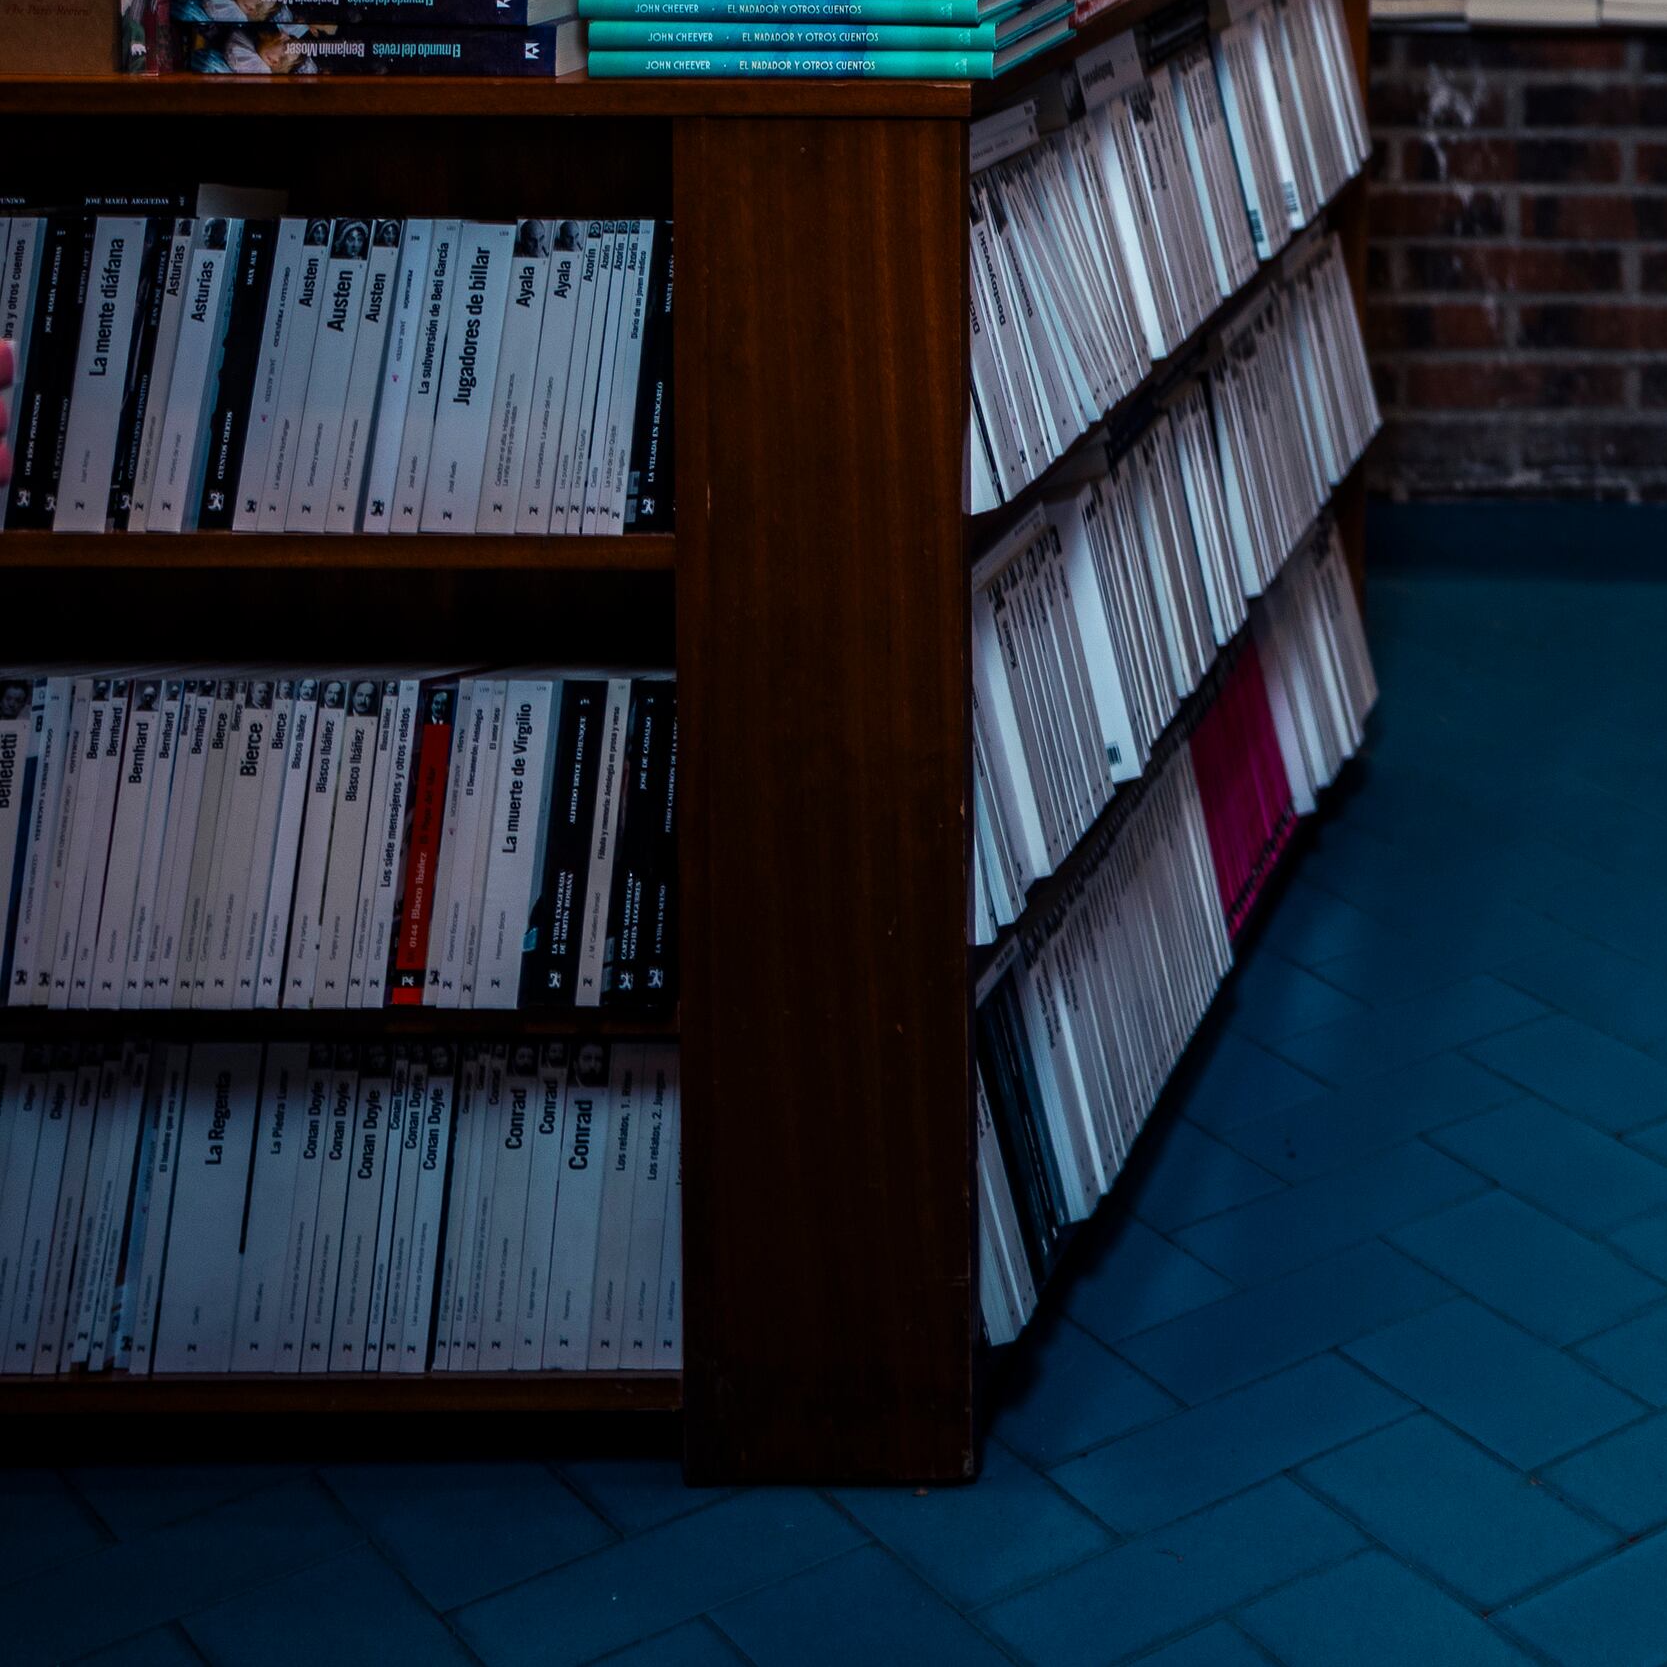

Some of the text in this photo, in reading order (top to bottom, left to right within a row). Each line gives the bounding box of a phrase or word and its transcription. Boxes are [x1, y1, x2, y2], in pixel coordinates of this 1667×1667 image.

[167, 245, 185, 297] Asturias
[191, 261, 214, 323] Asturias
[299, 258, 319, 308] Austen
[327, 270, 354, 332] Austen
[516, 266, 536, 308] Ayala
[90, 238, 125, 377] La mente diáfana
[418, 242, 452, 394] La subversión de Beti García
[453, 246, 492, 406] Jugadores de billar
[86, 709, 103, 760] Bernhard
[212, 712, 228, 749] Bierce
[316, 719, 335, 793] Blasco Ibáñez
[503, 703, 532, 854] La muerte de Virgilio
[205, 1071, 232, 1166] La Regenta
[303, 1081, 323, 1159] Conan Doyle
[505, 1089, 527, 1150] Conrad
